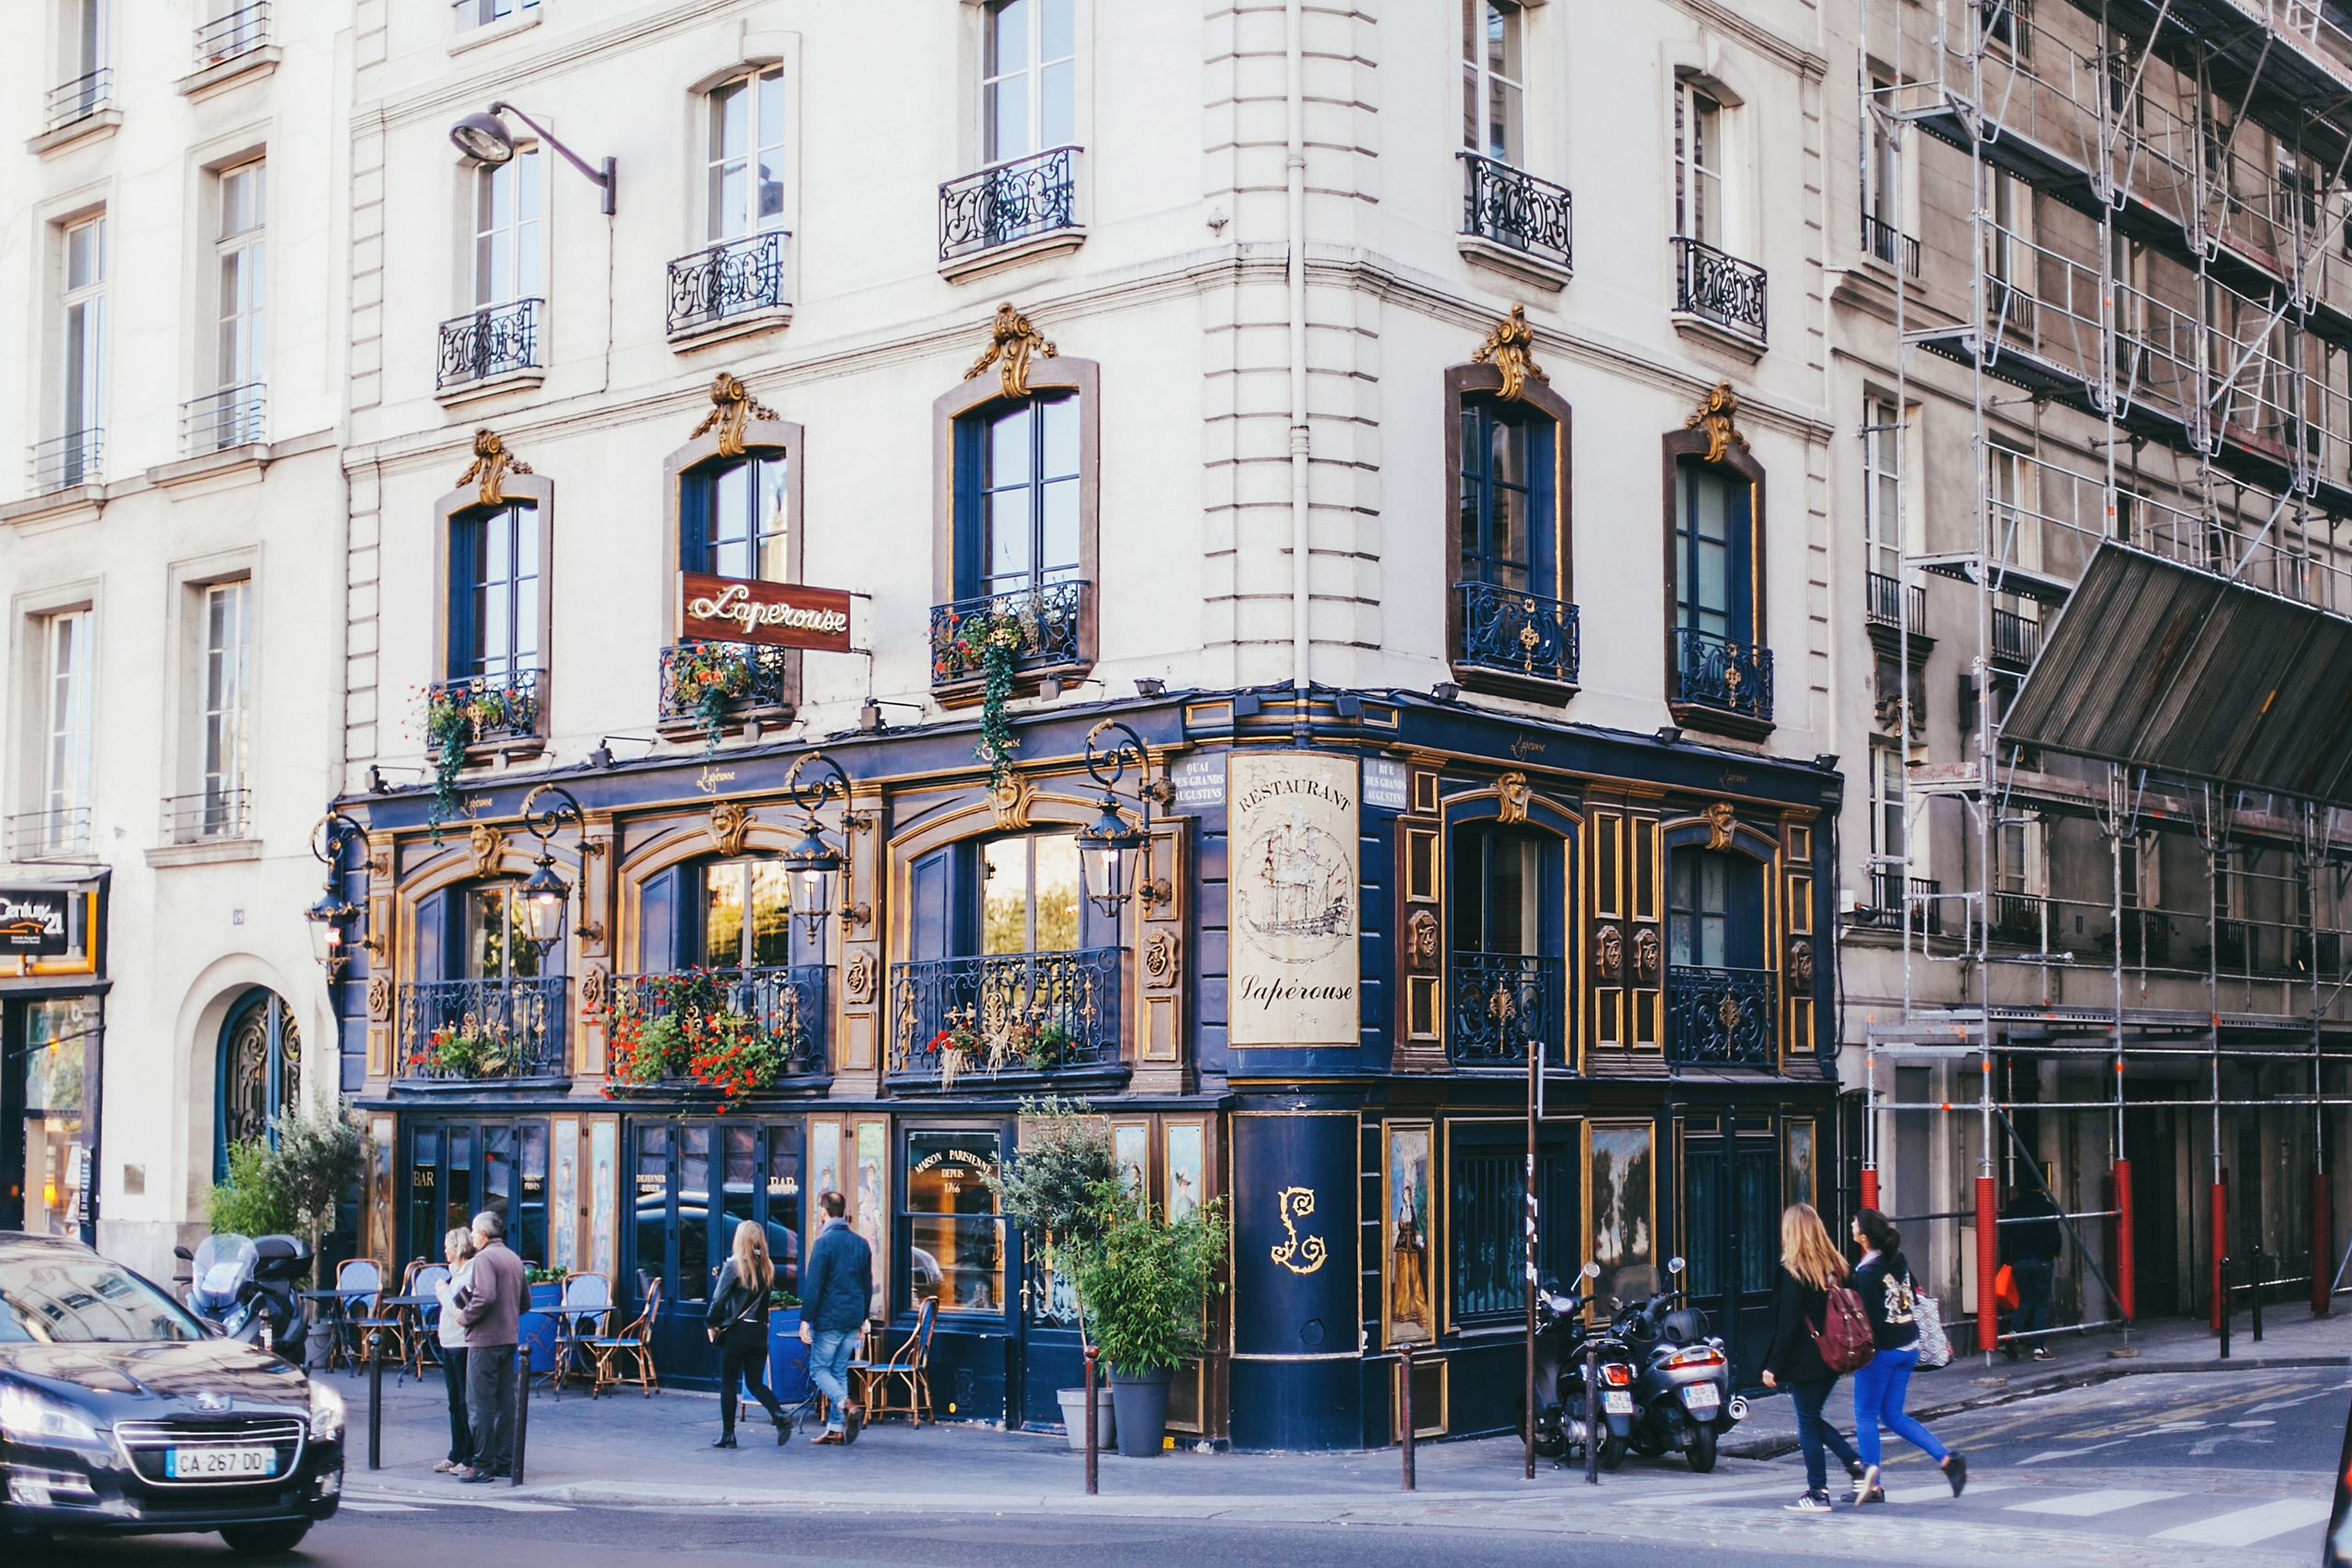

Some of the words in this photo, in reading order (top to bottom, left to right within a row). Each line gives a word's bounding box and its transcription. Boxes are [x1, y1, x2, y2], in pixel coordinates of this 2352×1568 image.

[1186, 762, 1209, 775] QUAI
[1379, 764, 1395, 776] RUE
[1189, 774, 1225, 786] GRANDS
[1365, 776, 1379, 787] DES
[1380, 778, 1407, 790] GRANDS
[1238, 779, 1351, 813] RESTAURANT
[1368, 790, 1407, 804] AUGUSTINS
[1238, 975, 1352, 1010] Lapérouse
[915, 1152, 943, 1175] MAISON
[949, 1149, 993, 1176] PARISIENNE
[413, 1171, 435, 1187] BAR
[941, 1168, 965, 1179] DEPUIS
[770, 1176, 796, 1194] BAR
[944, 1182, 961, 1193] 1766
